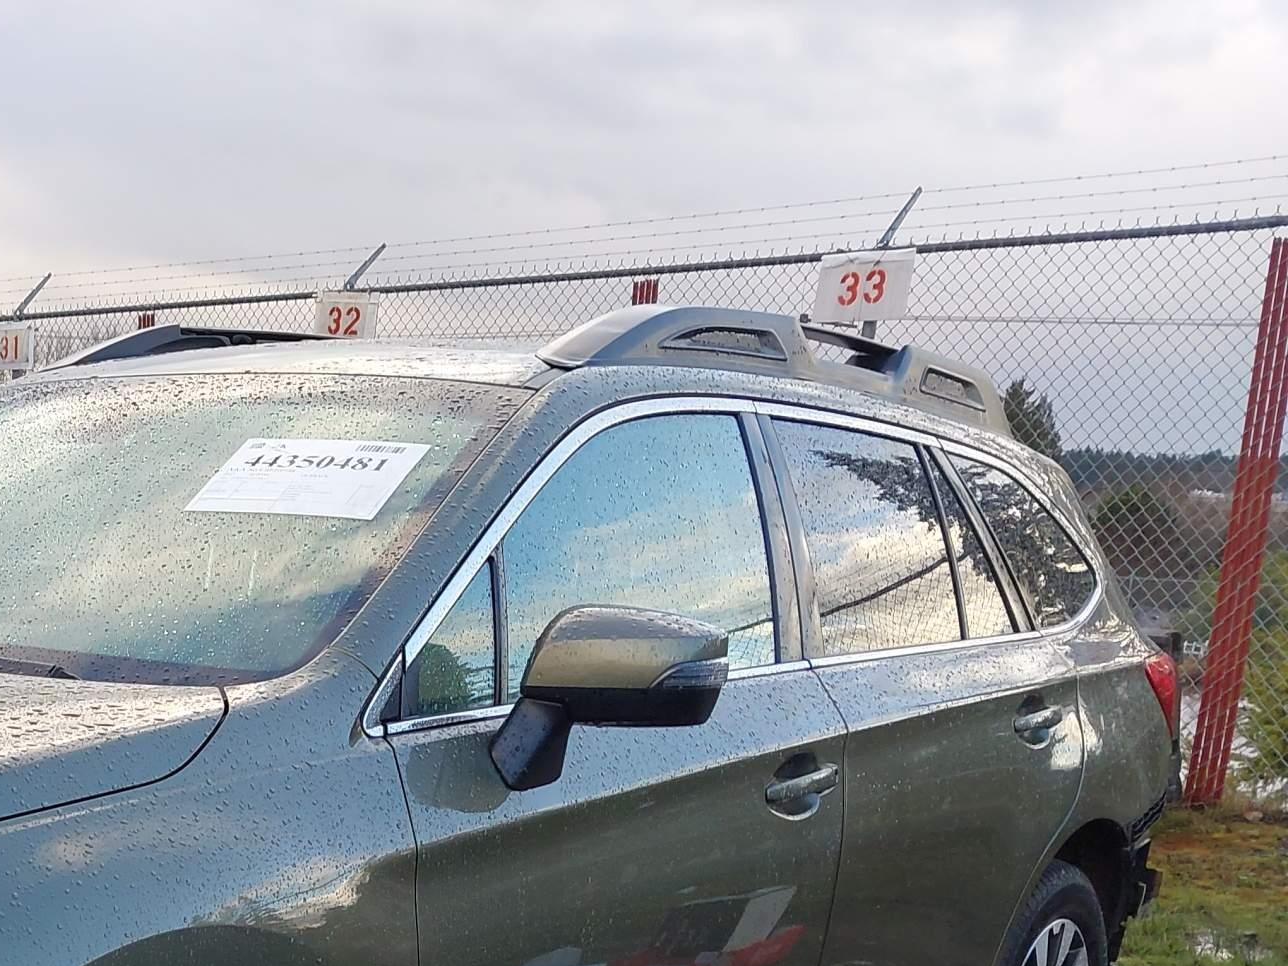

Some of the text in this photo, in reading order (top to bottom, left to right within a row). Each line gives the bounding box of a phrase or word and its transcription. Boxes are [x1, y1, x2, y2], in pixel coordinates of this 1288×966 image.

[837, 269, 886, 306] 33
[327, 306, 361, 335] 32
[0, 335, 19, 361] 31
[244, 454, 389, 472] 44350481
